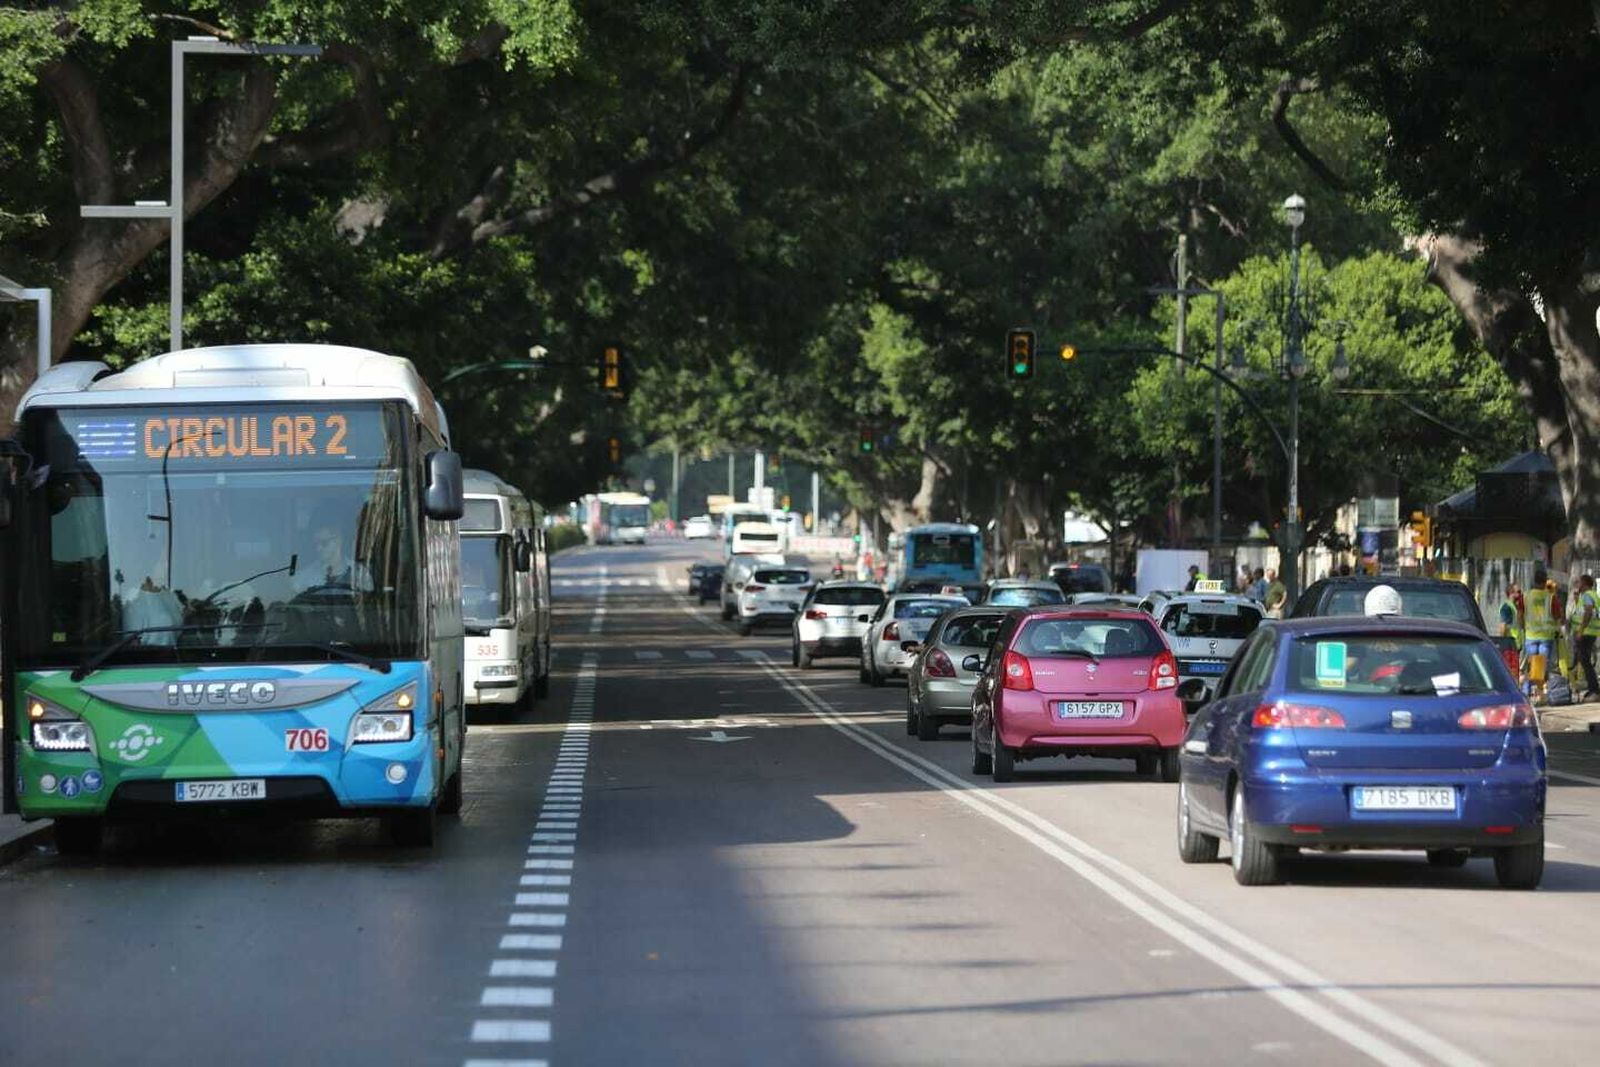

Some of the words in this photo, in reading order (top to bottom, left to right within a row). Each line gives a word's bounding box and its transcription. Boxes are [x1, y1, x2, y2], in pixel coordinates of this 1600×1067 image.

[144, 415, 316, 457] CIRCULAR
[325, 414, 348, 455] 2
[477, 644, 499, 656] 535
[167, 682, 277, 706] IVECO
[1066, 703, 1094, 714] 6157
[1099, 702, 1121, 714] GPX
[286, 729, 327, 750] 706
[188, 783, 226, 799] 5772
[231, 781, 260, 797] KBW
[1365, 788, 1410, 804] 7185
[1418, 788, 1451, 804] DKB
